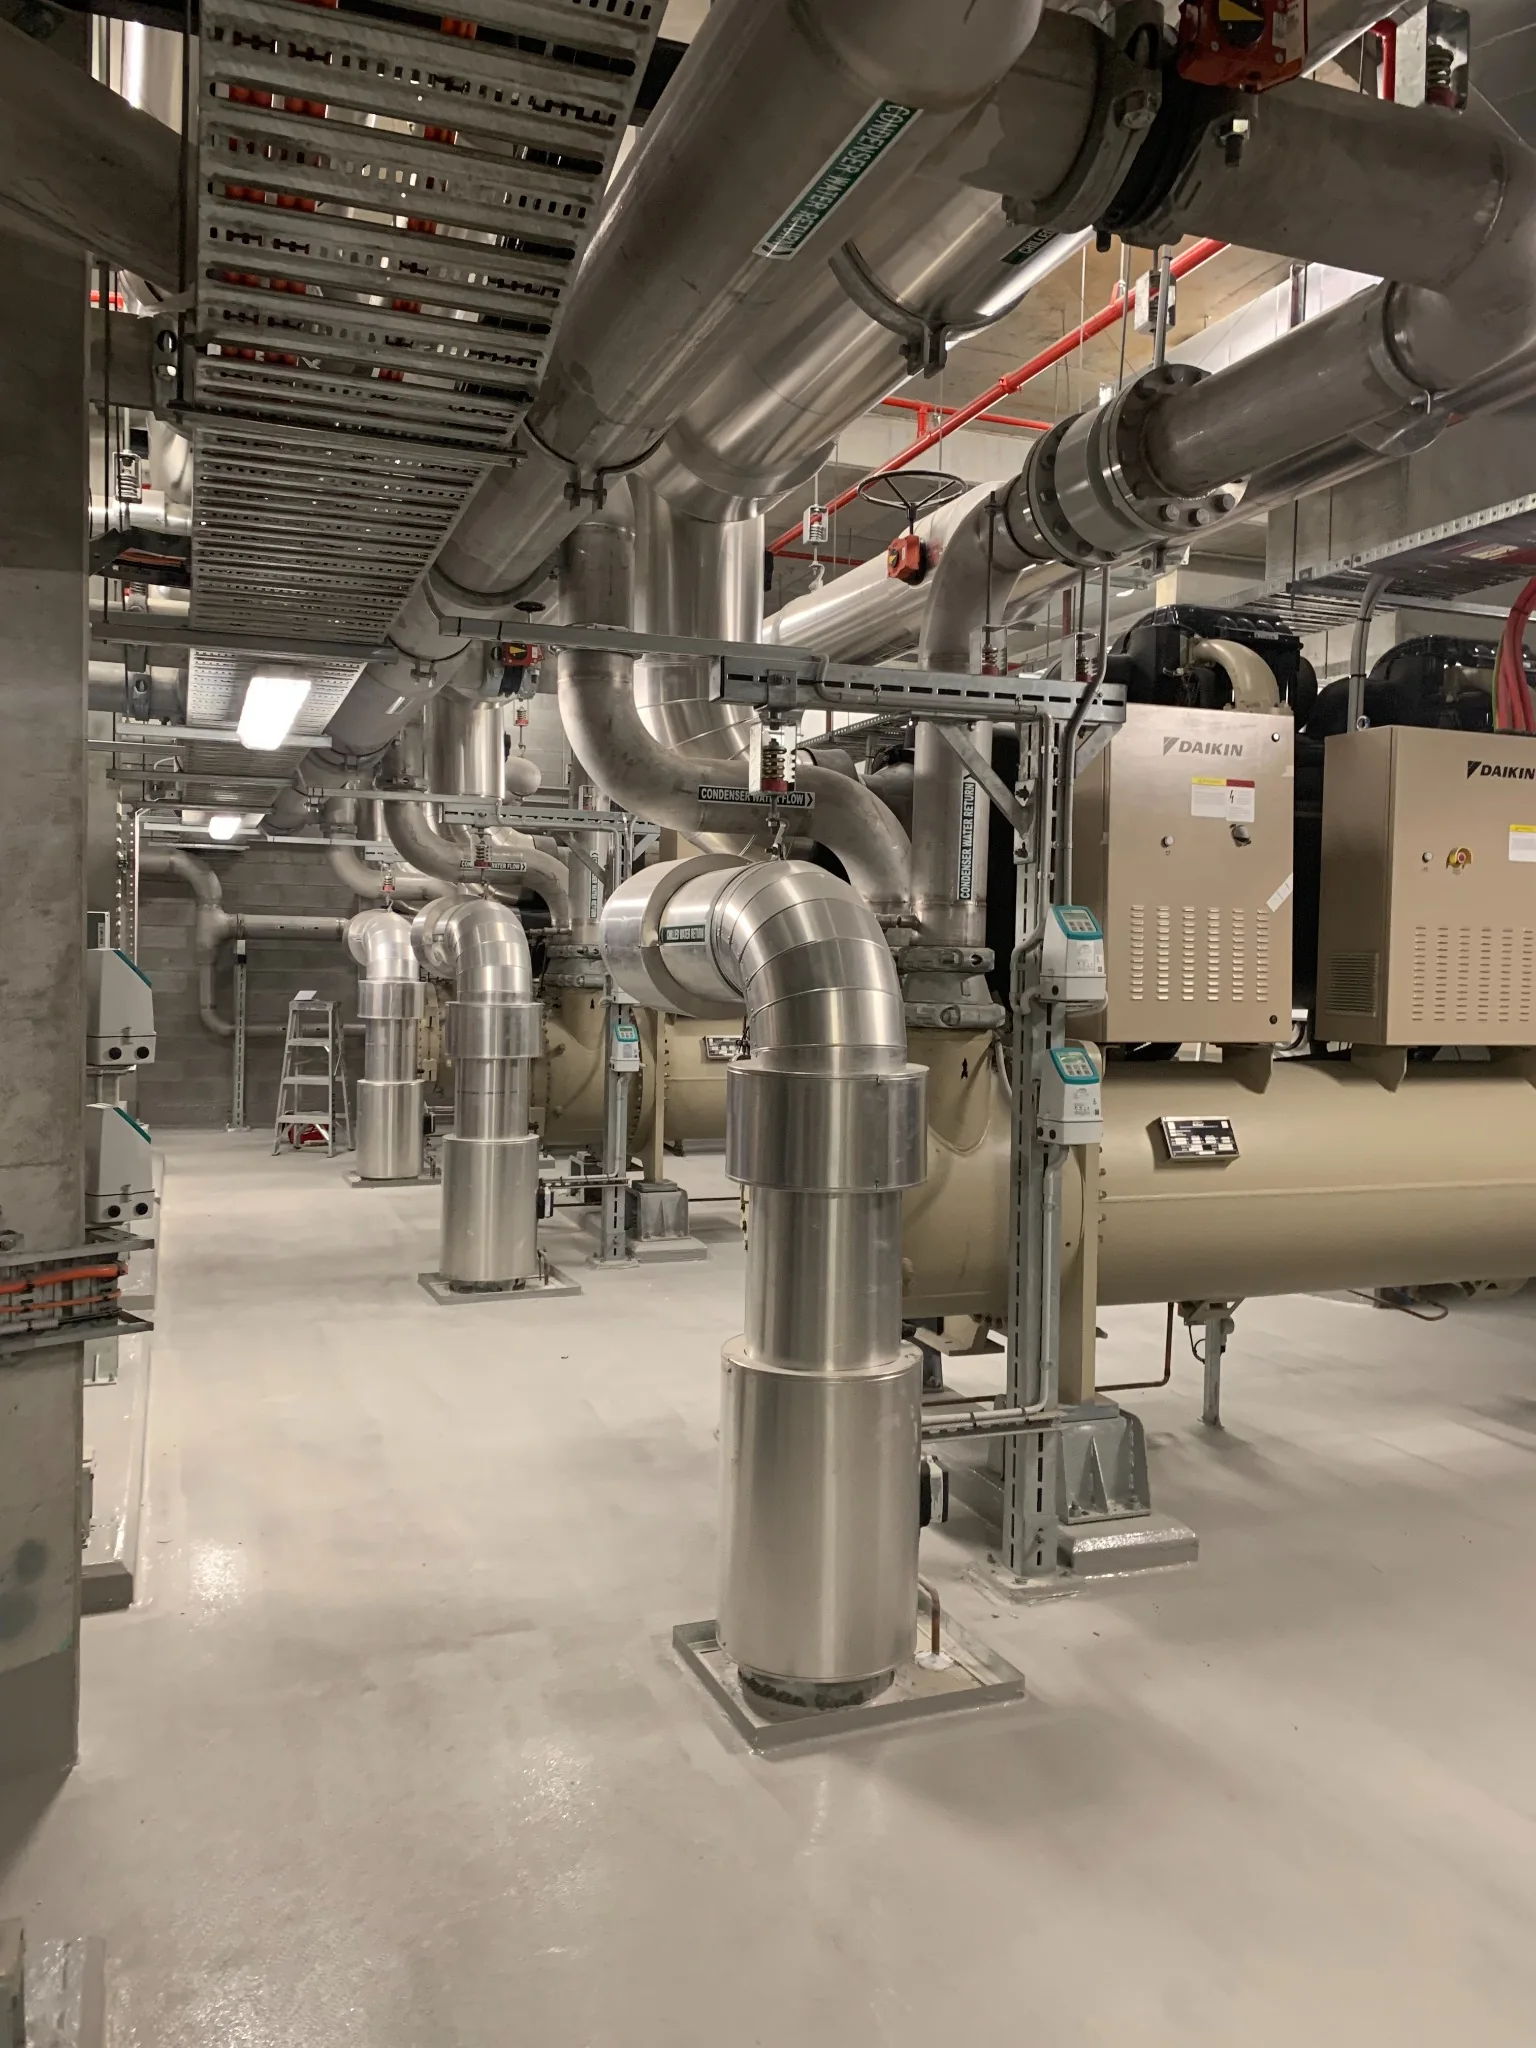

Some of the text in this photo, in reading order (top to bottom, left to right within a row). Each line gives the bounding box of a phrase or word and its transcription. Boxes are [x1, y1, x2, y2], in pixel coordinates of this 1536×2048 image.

[771, 104, 911, 249] CONDENSER WATER RETURN
[1178, 740, 1244, 757] DAIKIN
[1480, 764, 1536, 780] DAIKIN
[700, 787, 750, 802] CONDENSER
[781, 793, 804, 805] FLOW
[960, 783, 975, 899] CONDENSER WATER RETURN
